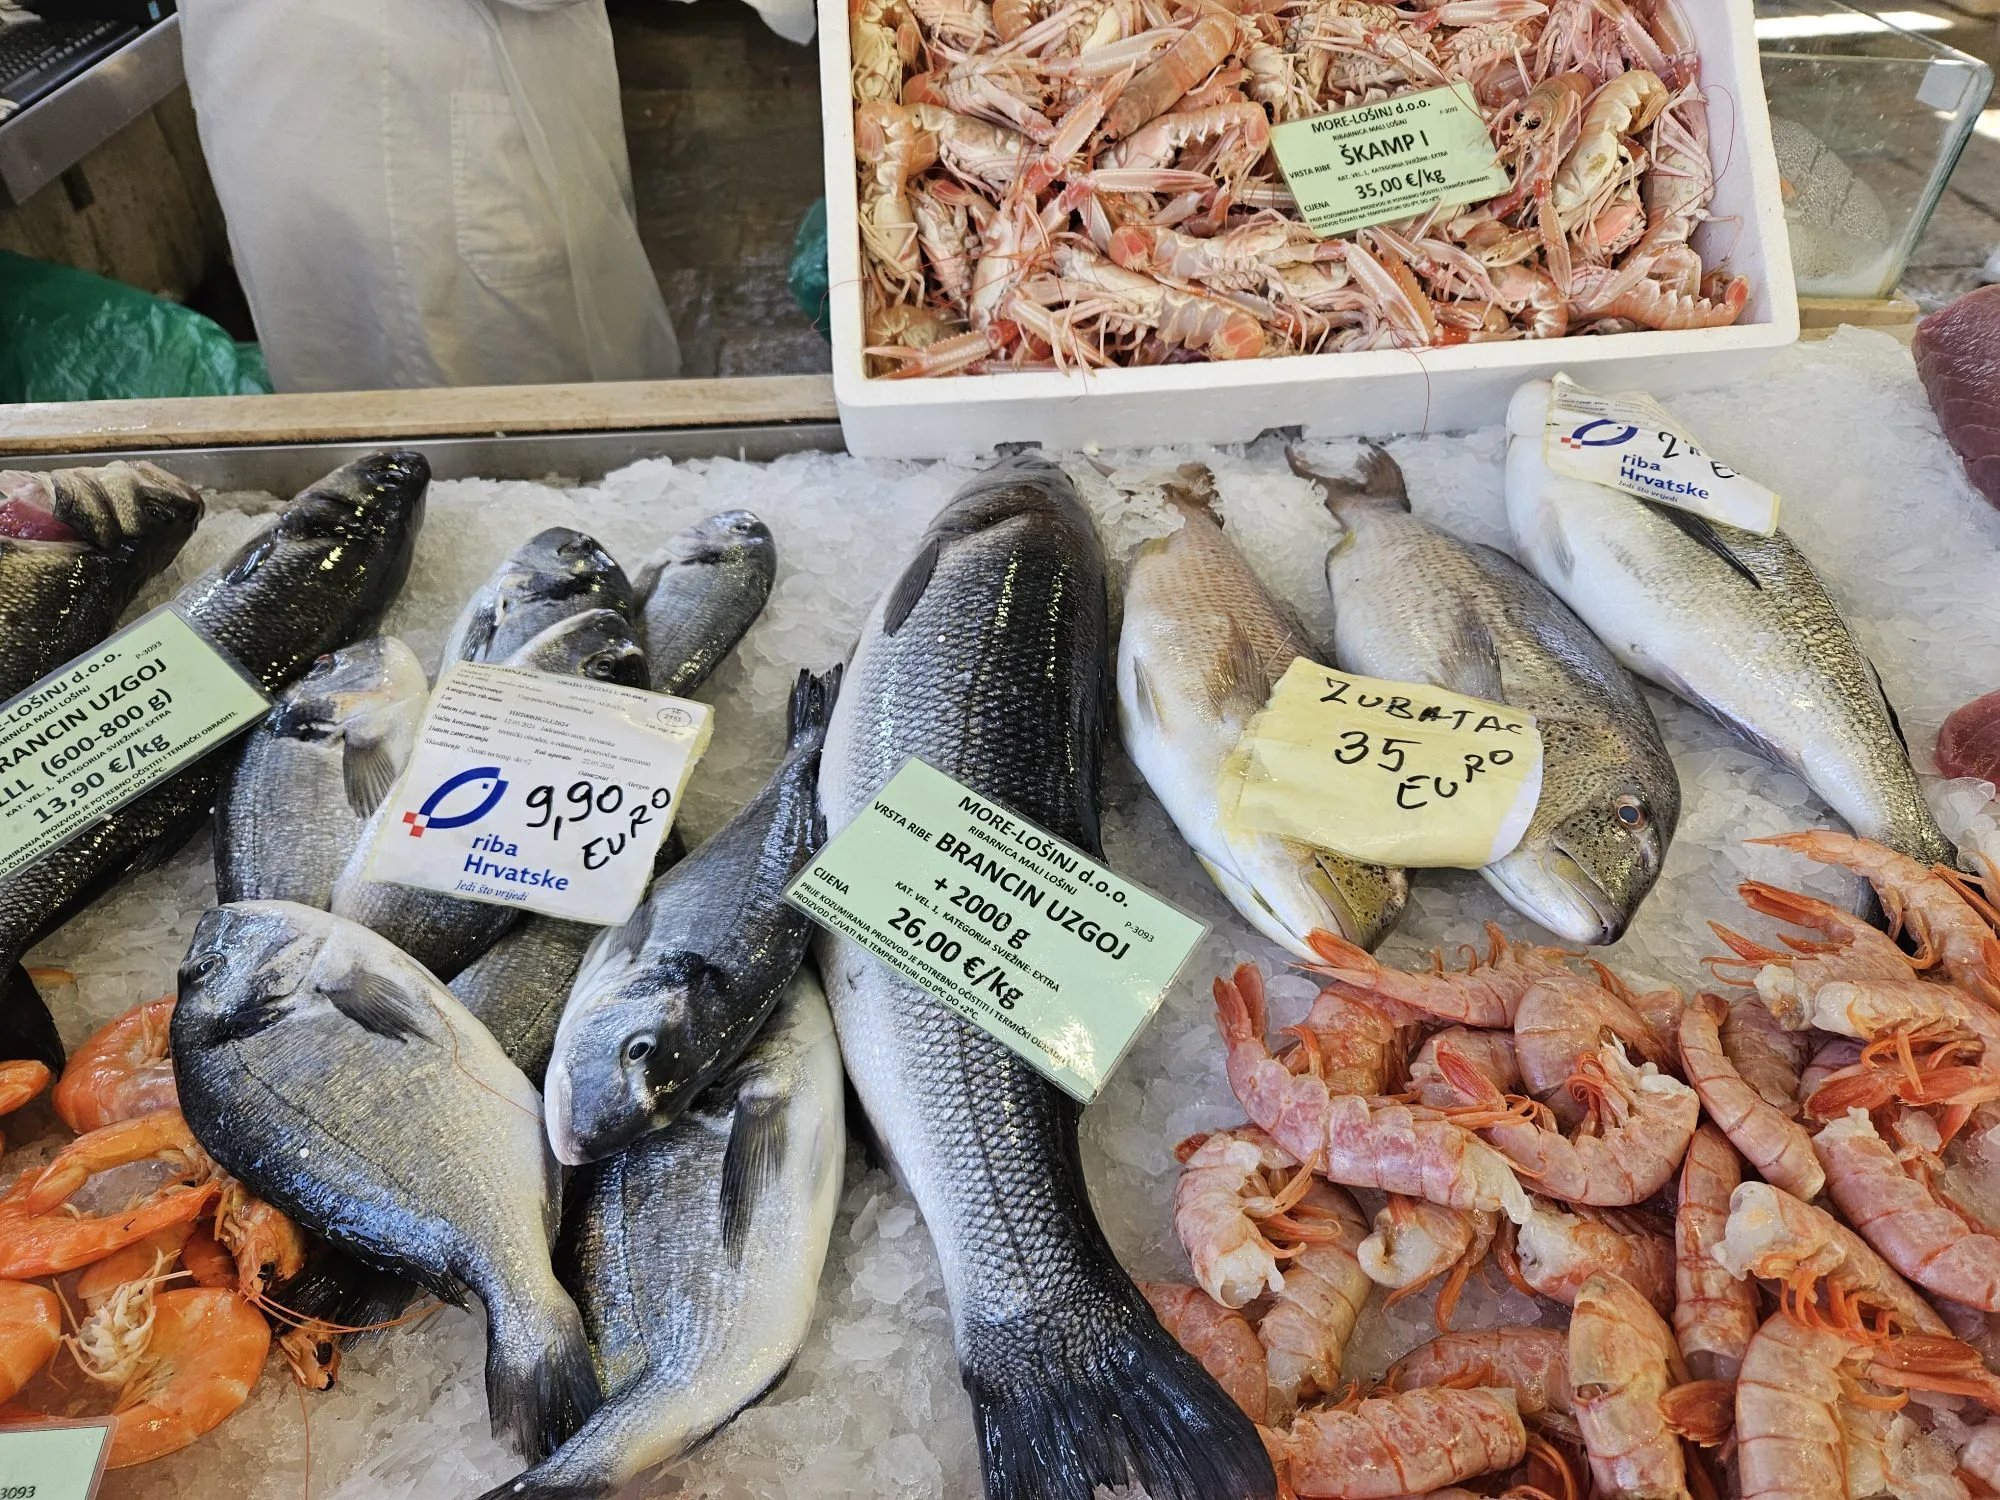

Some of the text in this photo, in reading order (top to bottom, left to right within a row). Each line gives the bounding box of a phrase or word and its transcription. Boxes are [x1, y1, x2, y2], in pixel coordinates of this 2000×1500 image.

[1311, 99, 1430, 134] MORE-LOŠINJ d.o.o.
[1332, 128, 1368, 140] RIBARNICA
[1368, 123, 1385, 132] MALI
[1338, 133, 1414, 165] ŠKAMP
[1430, 150, 1448, 159] EXTRA
[1288, 163, 1329, 178] VRSTA RIBE
[1354, 168, 1445, 199] 35,00 €/kg
[1303, 200, 1330, 212] CIJENA
[1620, 466, 1710, 500] Hrvatske
[1622, 454, 1661, 472] riba
[71, 653, 121, 683] d.o.o.
[135, 640, 162, 659] P-3093
[32, 705, 58, 723] MALI
[58, 684, 90, 707] LOŠINJ
[88, 657, 166, 710] UZGOJ
[40, 705, 143, 777] (600-800
[147, 687, 172, 711] g)
[1334, 730, 1423, 772] 35
[5, 804, 25, 817] KAT.
[25, 792, 45, 803] VEL.
[56, 751, 106, 784] KATEGORIJA
[106, 726, 144, 752] SVJEŽINE:
[144, 710, 171, 727] EXTRA
[32, 733, 170, 823] 13,90 €/kg
[40, 810, 80, 837] PROIZVOD
[89, 777, 131, 805] POTREBNO
[131, 757, 162, 778] OČISTITI
[166, 733, 201, 756] TERMIČKI
[201, 711, 237, 734] OBRADITI.
[1395, 749, 1513, 810] EURO
[8, 847, 38, 868] ČUVATI
[38, 839, 52, 849] NA
[51, 803, 106, 839] TEMPERATURI
[106, 795, 118, 805] OD
[133, 778, 145, 788] DO
[526, 780, 623, 840] 9,90
[581, 787, 671, 870] EURO
[874, 800, 932, 841] VRSTA RIBE
[471, 833, 519, 857] riba
[957, 795, 1127, 907] MORE-LOŠINJ d.o.o.
[967, 825, 1077, 895] RIBARNICA MALI LOŠINJ
[454, 880, 530, 901] Jedi što vrijedi
[463, 853, 569, 891] Hrvatske
[813, 867, 849, 894] CIJENA
[934, 831, 1130, 959] BRANCIN UZGOJ
[934, 877, 1031, 949] + 2000 g
[792, 890, 829, 917] PROIZVOD
[855, 933, 868, 944] NA
[868, 941, 919, 979] TEMPERATURI
[918, 976, 931, 987] OD
[945, 993, 959, 1006] DO
[894, 880, 1059, 992] KAT. VEL. 1, KATEGORIJA SVJEŽINE: EXTRA
[1124, 920, 1154, 942] P-3093
[800, 881, 820, 897] PRIJE
[818, 894, 870, 932] KOZUMIRANJA
[870, 928, 908, 957] PROIZVOD
[907, 954, 918, 963] JE
[916, 959, 957, 989] POTREBNO
[957, 987, 990, 1011] OČISTITI
[994, 1010, 1031, 1039] TERMIČKI
[887, 907, 1023, 1009] 26,00 €/kg
